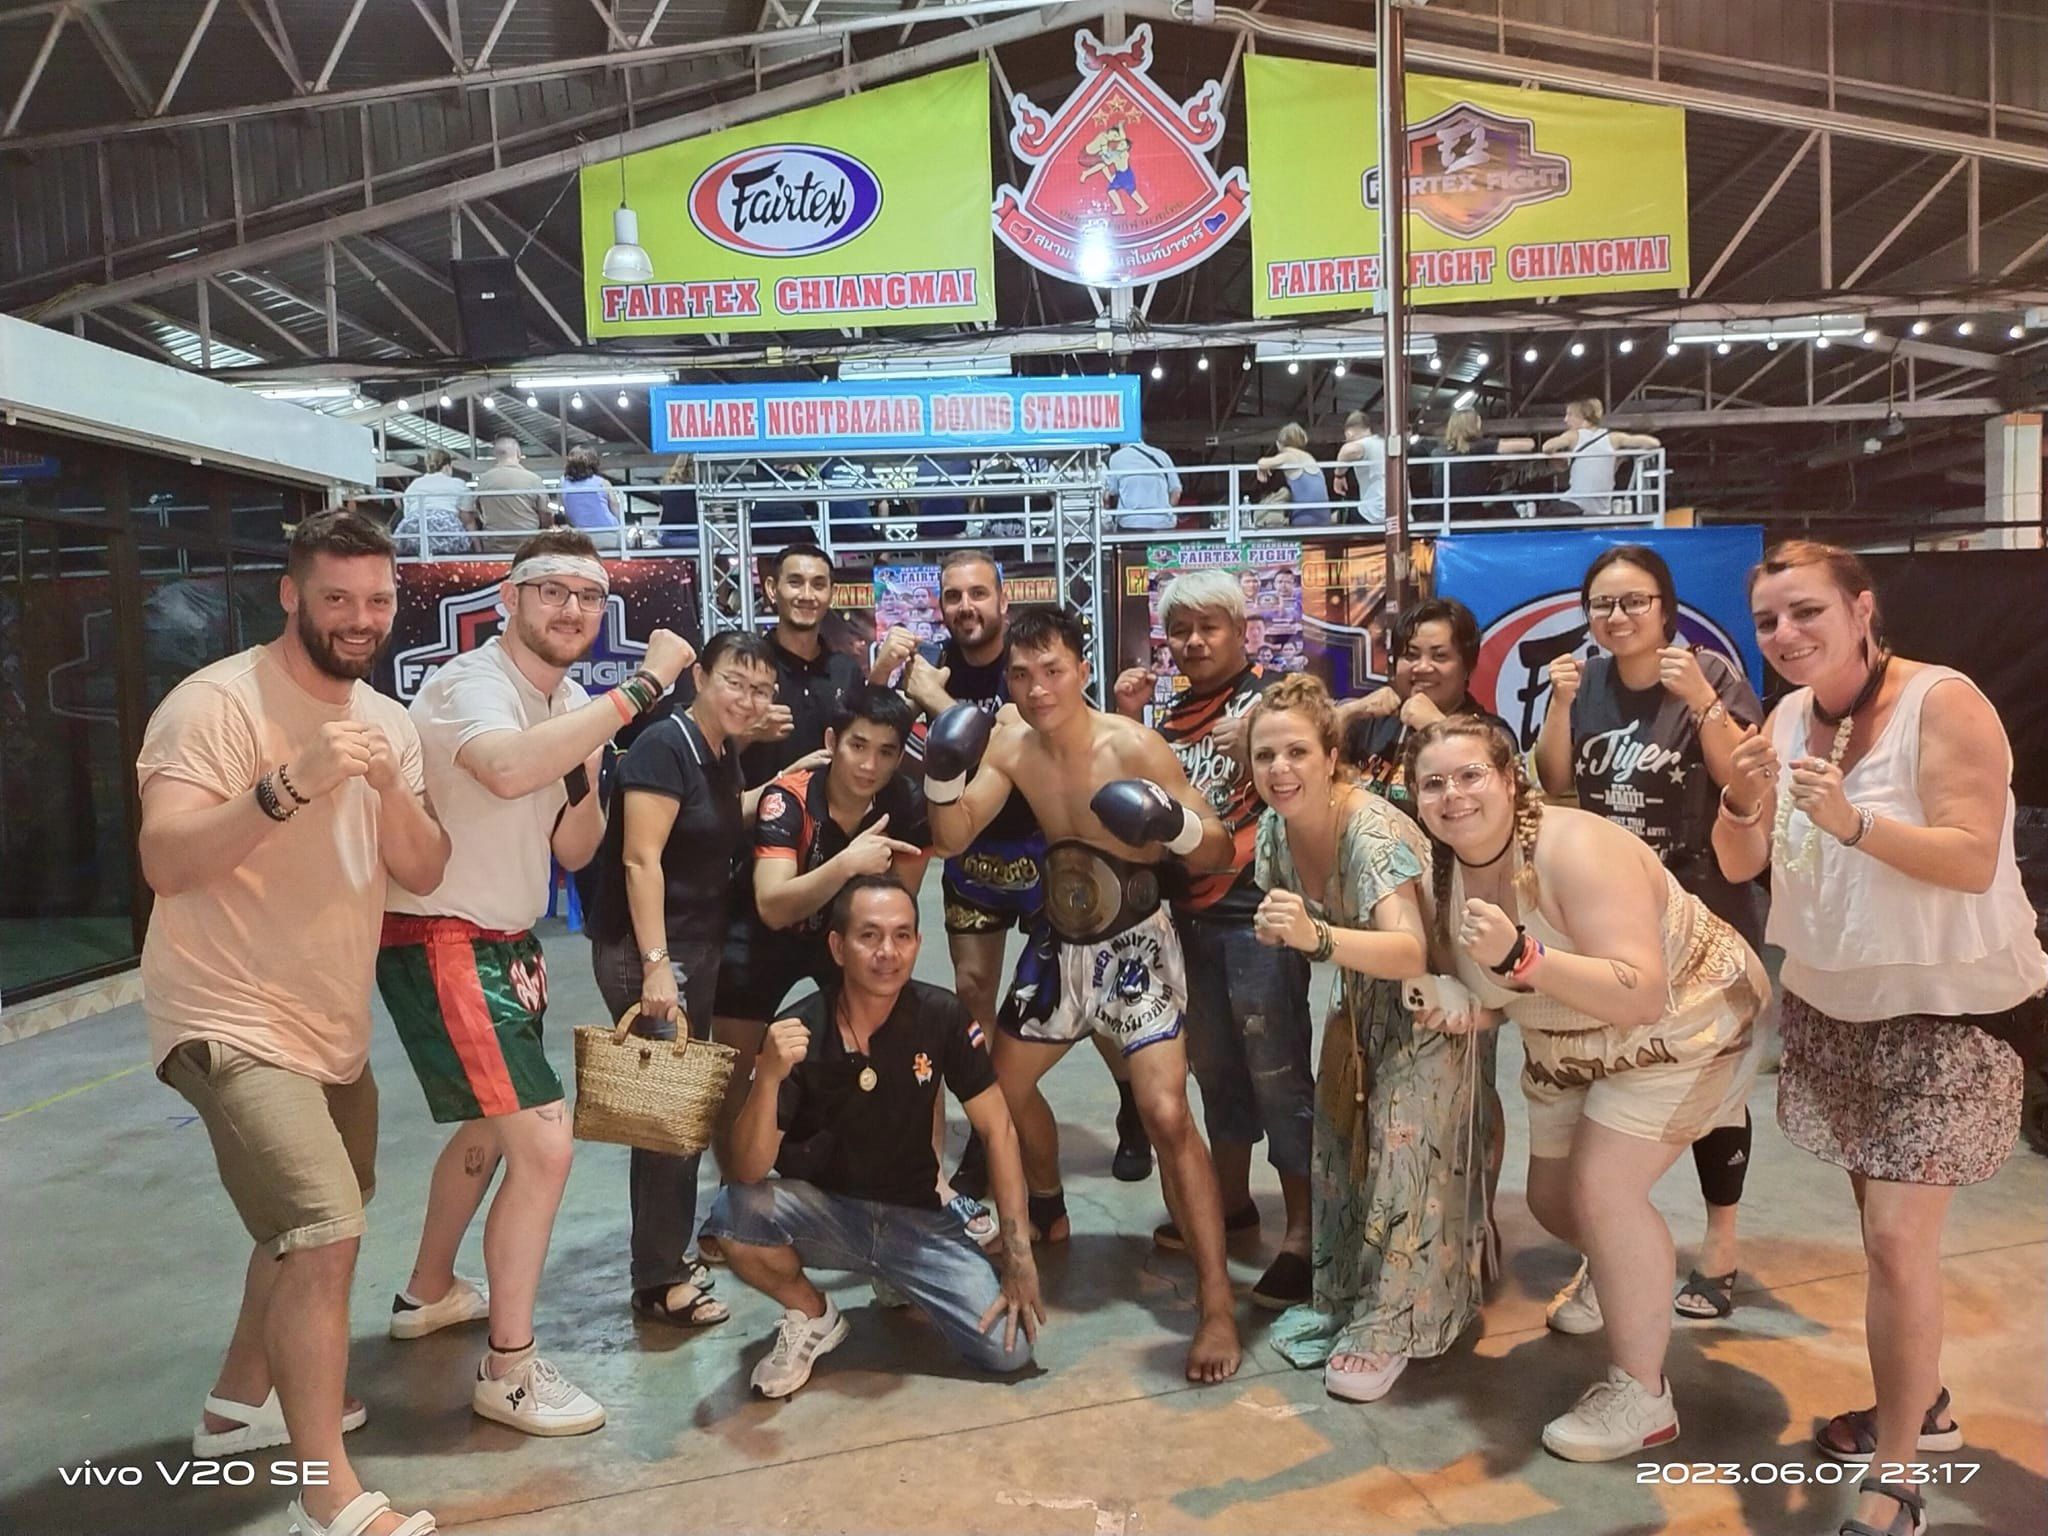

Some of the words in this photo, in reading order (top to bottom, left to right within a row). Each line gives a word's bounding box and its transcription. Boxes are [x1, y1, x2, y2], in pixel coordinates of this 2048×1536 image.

[731, 160, 848, 233] Fairtex
[1369, 174, 1477, 199] FRTEX
[1486, 168, 1563, 192] FIGHT
[1409, 247, 1497, 288] FIGHT
[1508, 236, 1670, 281] CHIANGMAI
[602, 279, 760, 323] FAIRTEX
[774, 269, 977, 315] CHIANGMAI
[668, 401, 756, 439] KALARE
[766, 397, 922, 437] NIGHTBAZAAR
[932, 394, 1012, 433] BOXING
[1022, 392, 1121, 431] STADIUM
[900, 572, 941, 584] FAIRT
[1179, 550, 1240, 563] FAIRTEX
[1248, 548, 1299, 562] FIGHT
[567, 661, 643, 686] FIGH
[1582, 718, 1682, 783] Tiger
